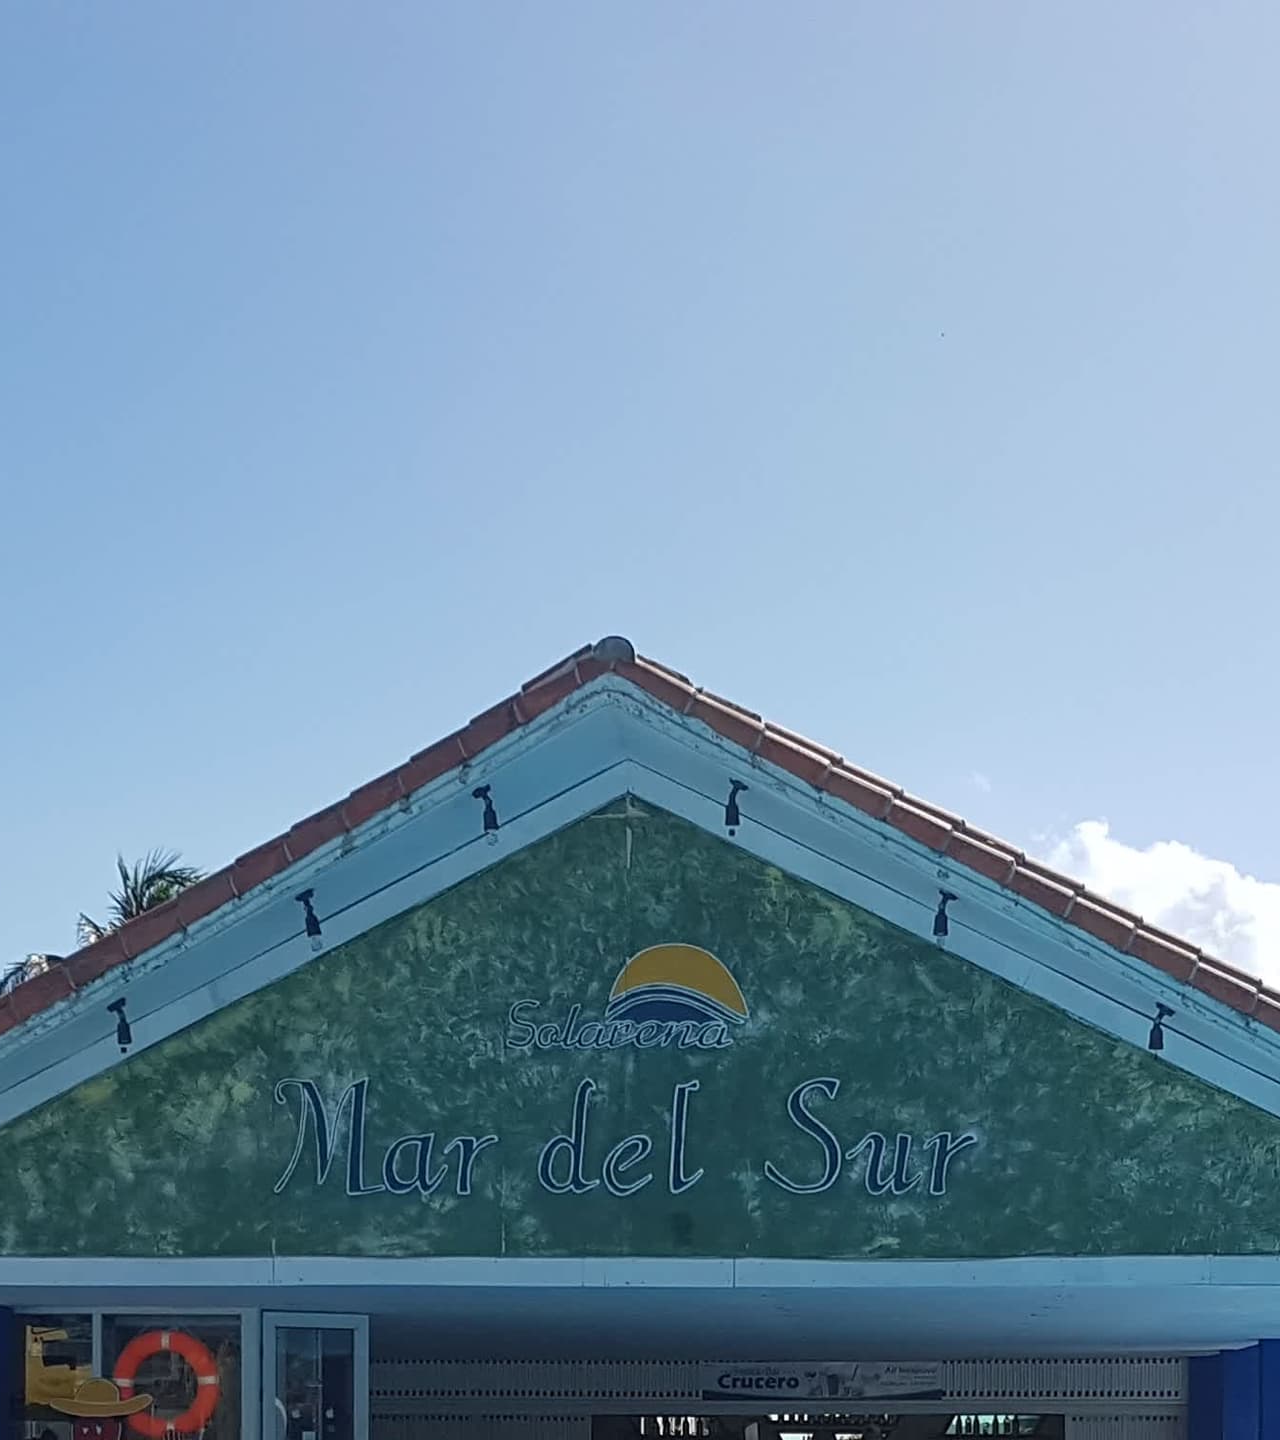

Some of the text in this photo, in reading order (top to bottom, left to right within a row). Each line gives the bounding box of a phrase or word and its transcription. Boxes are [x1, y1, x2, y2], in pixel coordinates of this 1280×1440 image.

[506, 1000, 733, 1049] Solarena
[273, 1076, 977, 1197] Mar del Sur
[718, 1373, 800, 1390] Crucero
